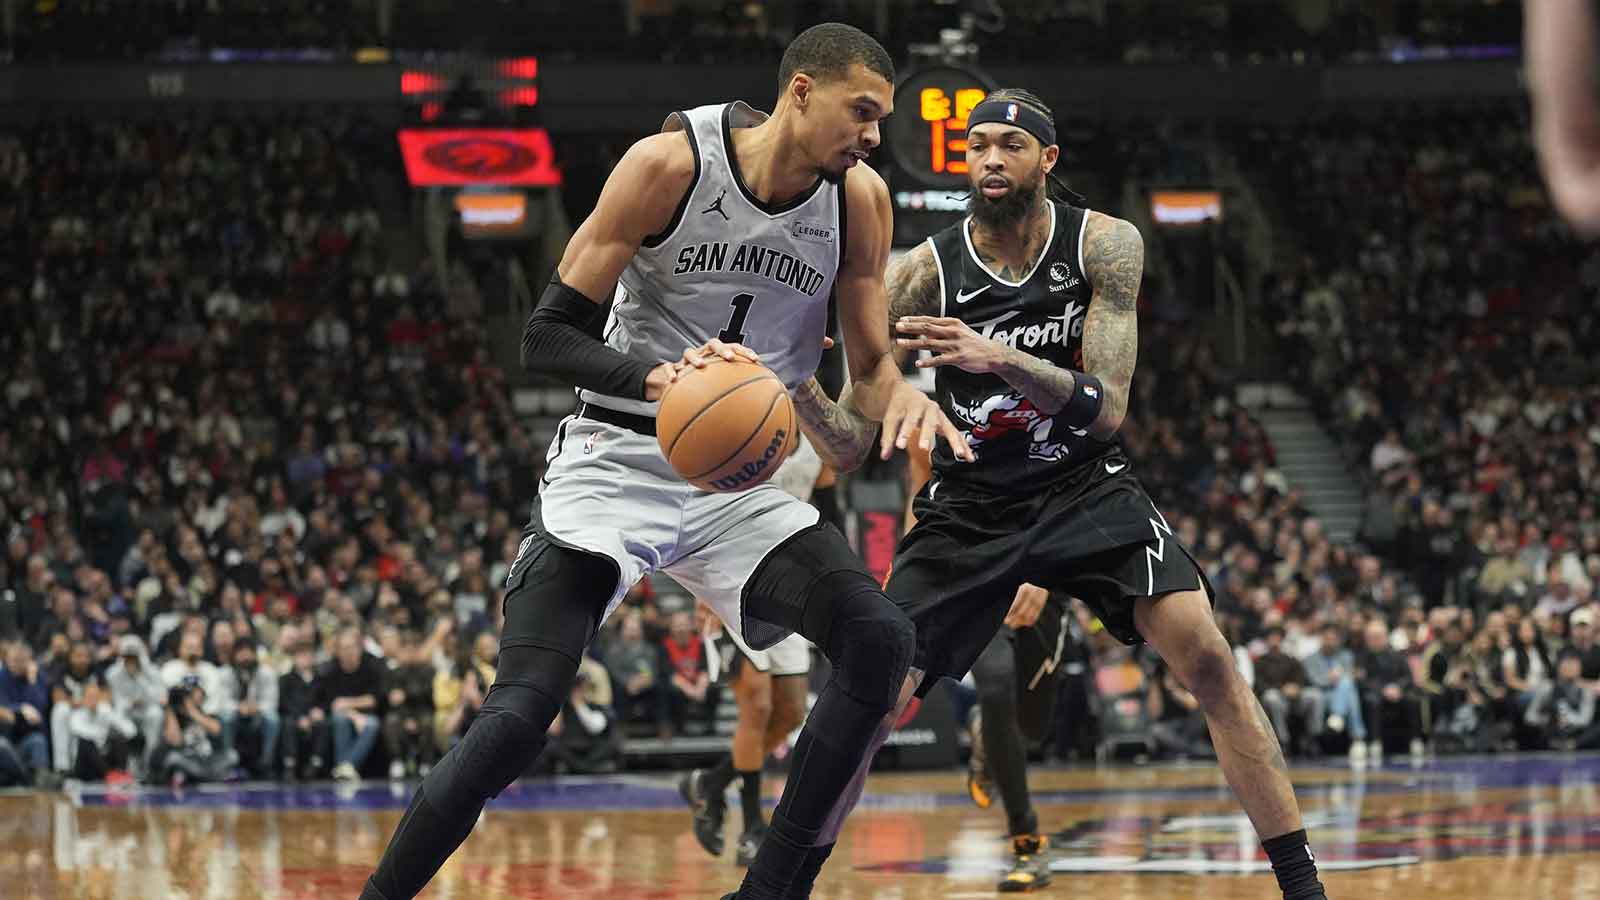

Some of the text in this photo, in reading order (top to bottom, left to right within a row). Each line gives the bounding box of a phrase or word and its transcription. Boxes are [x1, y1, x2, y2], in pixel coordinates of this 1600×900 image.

[798, 226, 830, 238] LEDGER
[673, 242, 825, 297] SAN ANTONIO
[1049, 277, 1080, 293] Sun Life
[717, 292, 755, 345] 1
[710, 429, 785, 490] Wilson
